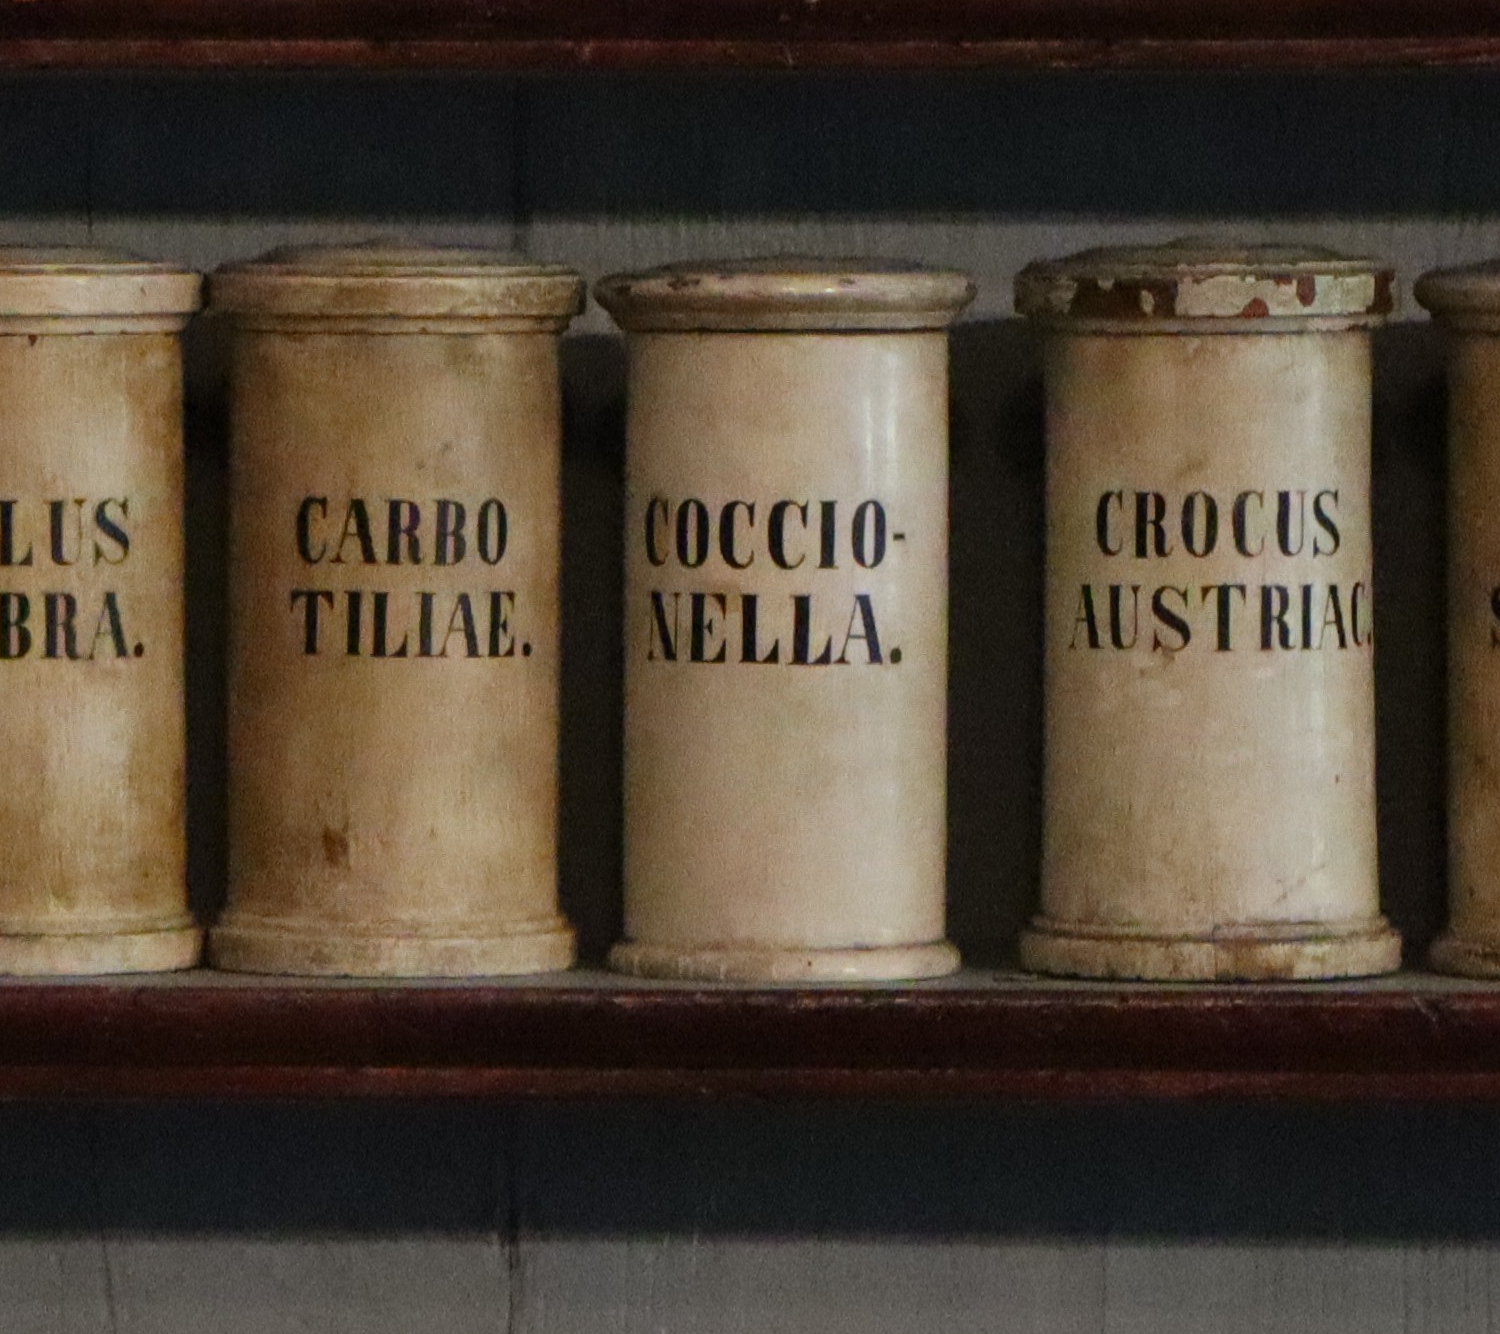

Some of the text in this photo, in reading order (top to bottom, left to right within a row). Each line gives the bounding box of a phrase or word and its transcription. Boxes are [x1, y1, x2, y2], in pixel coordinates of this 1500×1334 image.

[297, 497, 509, 566] CARBO
[645, 498, 905, 570] COCCIO-
[1095, 490, 1341, 560] CROCUS
[290, 590, 532, 658] TILIAE.
[648, 592, 902, 666] NELLA.
